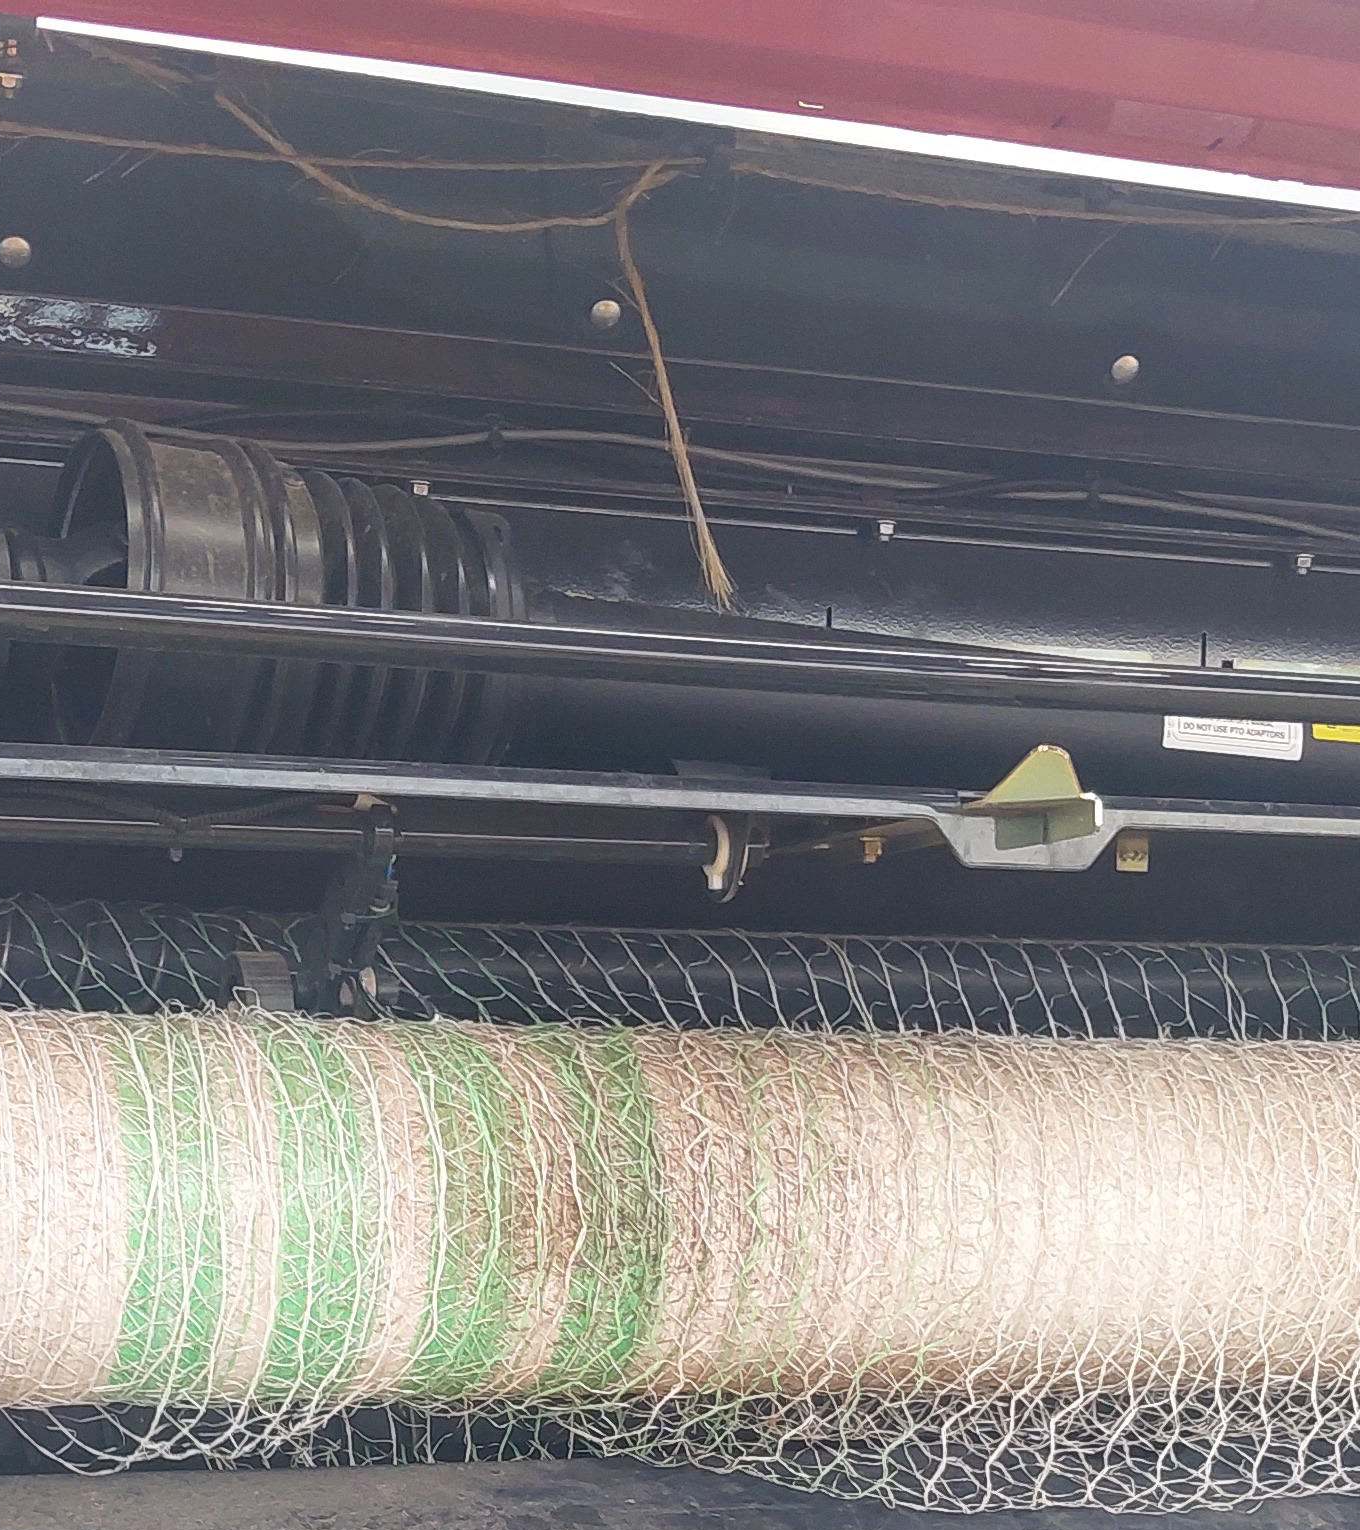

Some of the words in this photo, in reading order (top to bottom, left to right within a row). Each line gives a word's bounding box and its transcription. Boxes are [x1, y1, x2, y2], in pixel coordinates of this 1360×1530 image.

[1183, 721, 1195, 730] DO
[1196, 723, 1212, 732] NOT
[1213, 725, 1228, 733] USE
[1229, 726, 1245, 735] PTO
